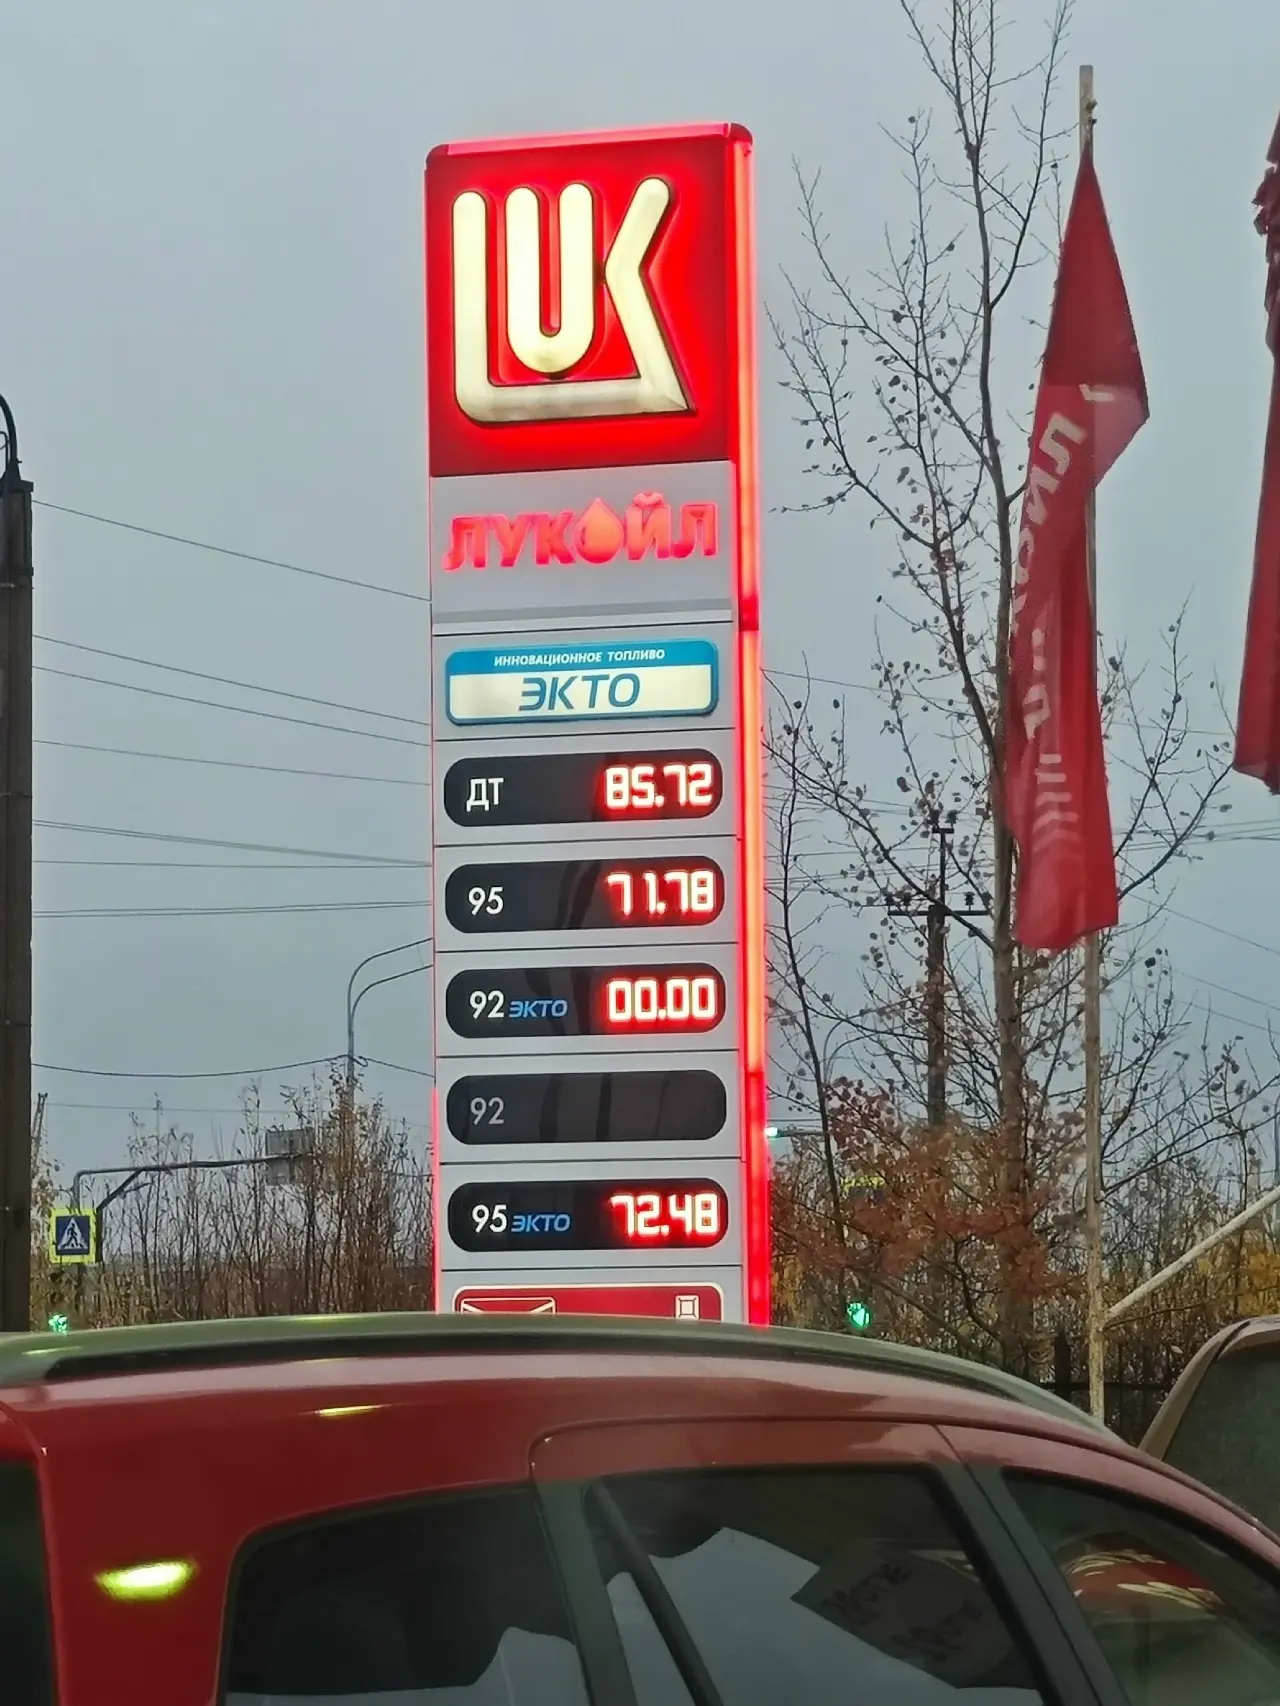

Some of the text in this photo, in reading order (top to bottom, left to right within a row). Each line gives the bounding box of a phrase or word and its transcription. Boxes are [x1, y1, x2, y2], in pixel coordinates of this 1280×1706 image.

[443, 492, 718, 571] ЛУКОЙЛ
[493, 648, 666, 667] ИННОВАЦИОННОЕ ТОПЛИВО
[518, 673, 641, 712] ЭКТО
[466, 777, 504, 812] ДТ
[605, 763, 713, 809] 85.72
[468, 887, 504, 916] 95
[607, 869, 715, 916] 71.78
[469, 990, 568, 1020] 92 ЭКТО
[608, 977, 716, 1022] 00.00
[470, 1097, 505, 1125] 92
[472, 1204, 571, 1234] 95 ЭКТО
[610, 1193, 719, 1238] 72.48
